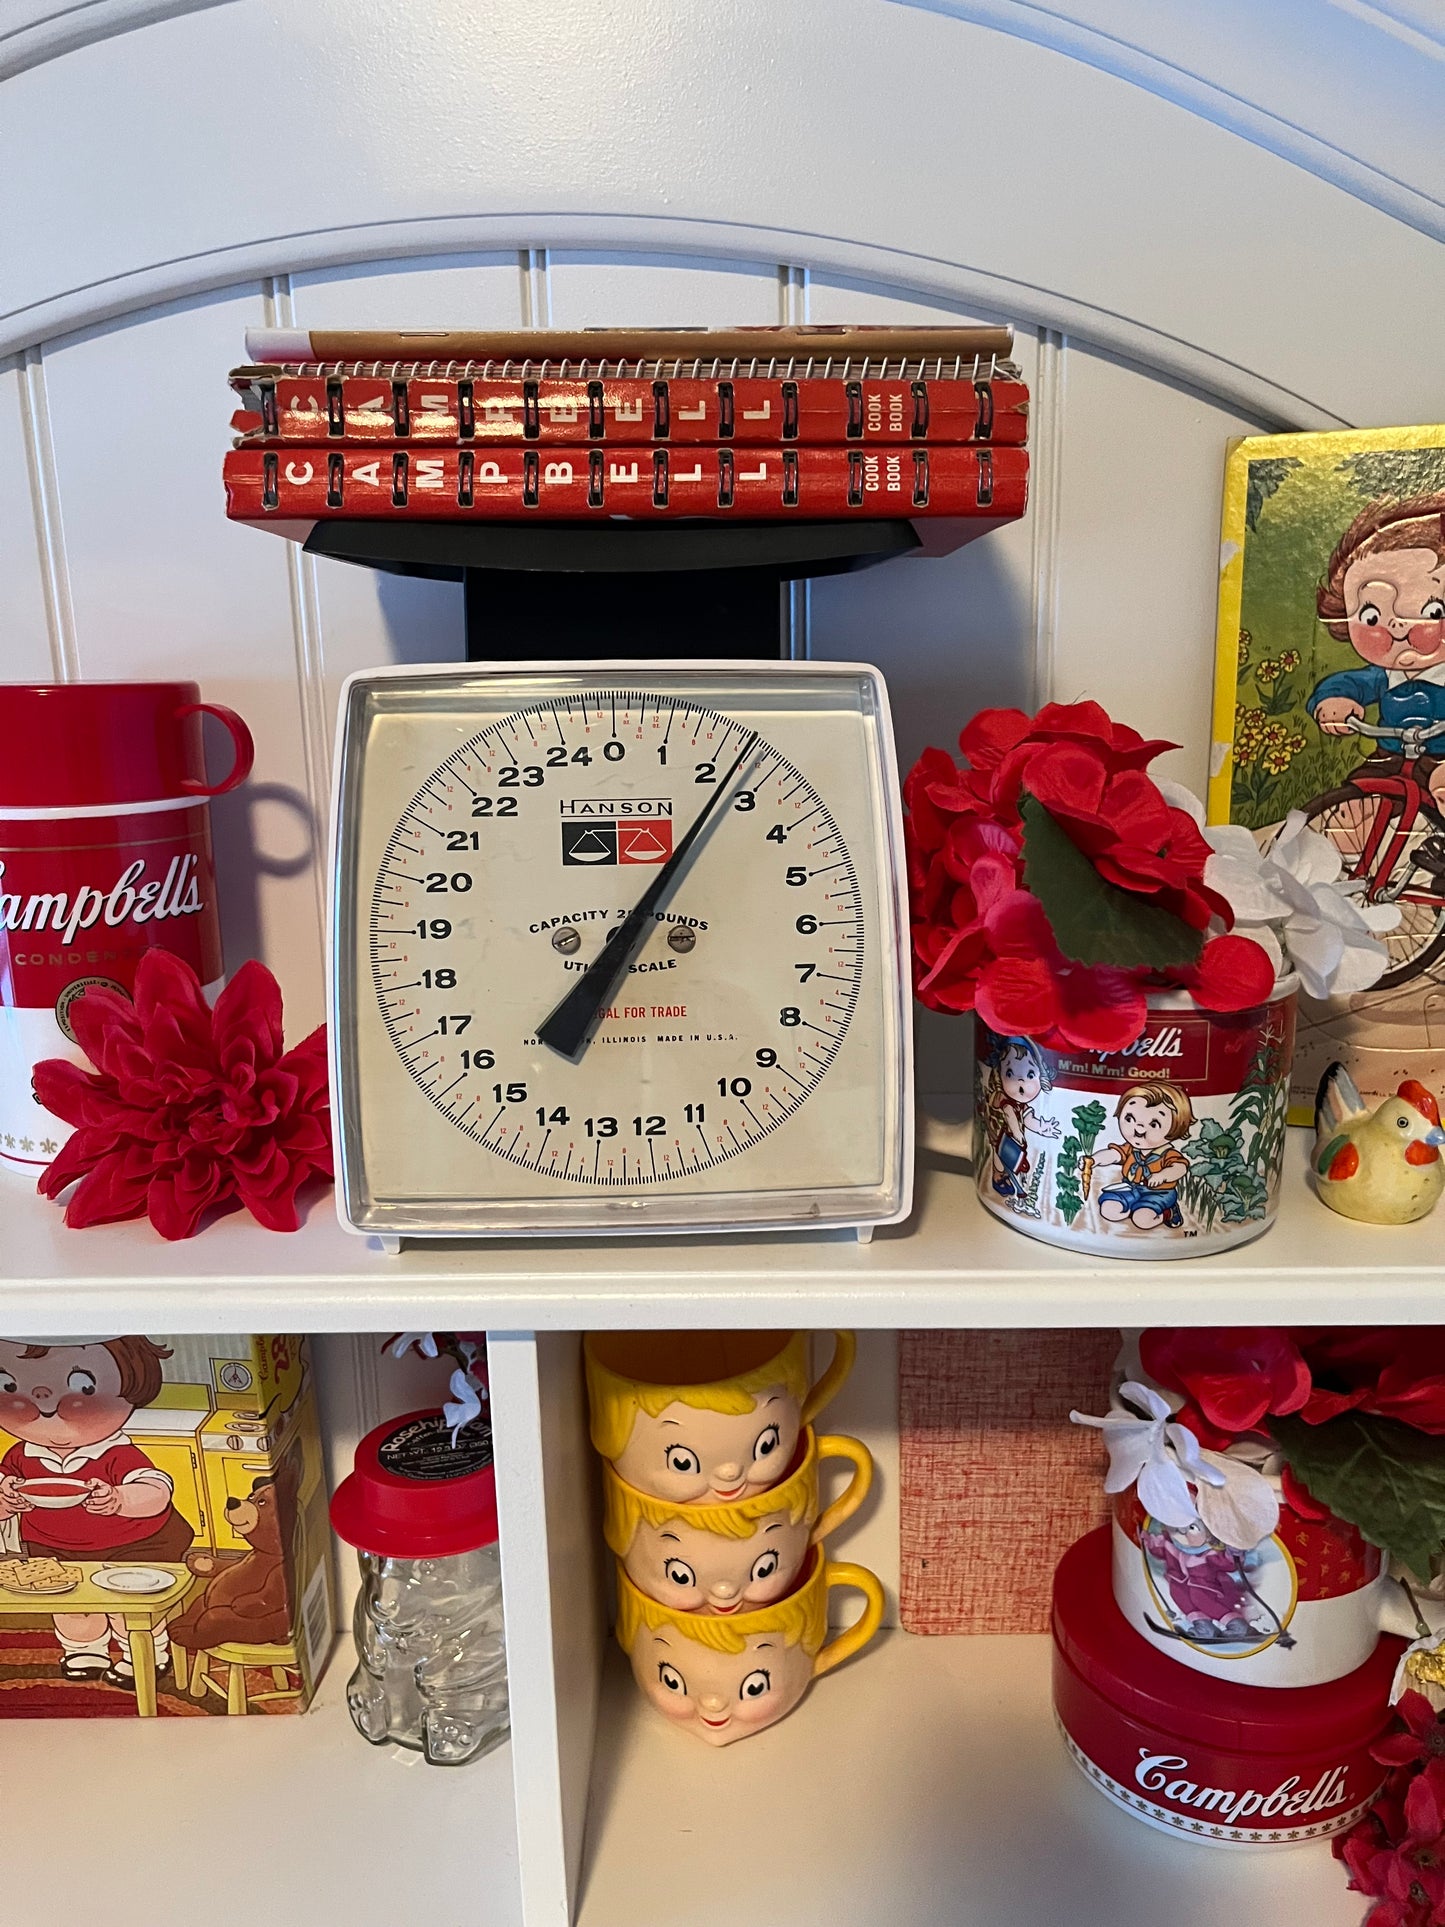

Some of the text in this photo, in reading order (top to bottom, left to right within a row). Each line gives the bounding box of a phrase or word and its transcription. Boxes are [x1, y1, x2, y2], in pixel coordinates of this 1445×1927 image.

[867, 393, 882, 432] COOK
[889, 393, 903, 432] BOOK
[285, 459, 767, 488] CAMPBELL
[865, 455, 879, 492] COOK
[887, 455, 900, 492] BOOK
[546, 747, 593, 767] 24
[604, 741, 626, 762] 0
[657, 745, 667, 765] 1
[498, 766, 545, 787] 23
[694, 763, 717, 783] 2
[471, 796, 519, 817] 22
[560, 799, 673, 816] HANSON
[733, 791, 756, 811] 3
[446, 830, 480, 851] 21
[765, 824, 787, 844] 4
[426, 872, 473, 893] 20
[785, 866, 807, 887] 5
[0, 853, 204, 944] ampbell's
[416, 919, 452, 939] 19
[529, 909, 609, 934] CAPACITY
[796, 914, 818, 934] 6
[628, 958, 677, 974] SCALE
[794, 963, 816, 983] 7
[422, 968, 457, 989] 18
[624, 1006, 646, 1018] FOR
[650, 1005, 688, 1018] TRADE
[780, 1006, 801, 1026] 8
[437, 1015, 472, 1035] 17
[602, 1036, 647, 1044] ILLINOIS
[657, 1034, 684, 1042] MADE
[690, 1034, 700, 1042] IN
[706, 1033, 739, 1041] U.S.A.
[460, 1049, 496, 1070] 16
[756, 1048, 777, 1068] 9
[1058, 1059, 1171, 1079] M'm! M'm! Good!
[492, 1083, 528, 1103] 15
[717, 1077, 752, 1097] 10
[536, 1106, 571, 1126] 14
[684, 1103, 705, 1123] 11
[584, 1117, 619, 1137] 13
[632, 1116, 667, 1136] 12
[1183, 1230, 1198, 1238] TM
[1134, 1747, 1351, 1824] Campbell's
